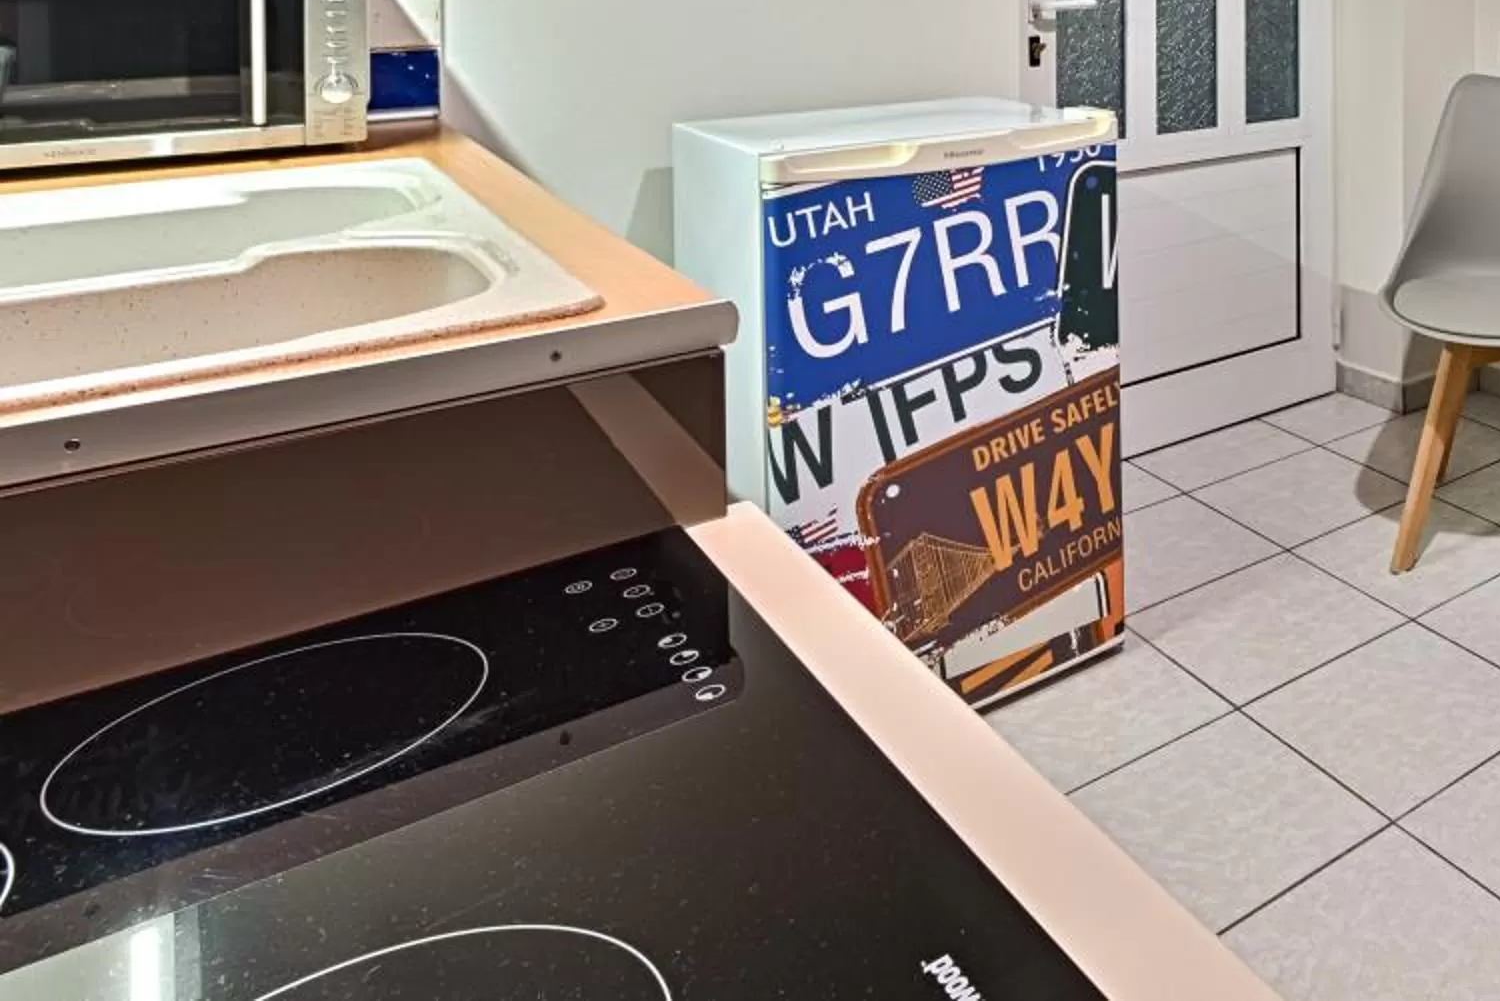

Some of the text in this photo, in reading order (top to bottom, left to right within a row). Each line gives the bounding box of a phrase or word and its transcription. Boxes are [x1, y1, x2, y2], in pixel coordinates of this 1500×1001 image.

[767, 191, 876, 248] UTAH
[786, 189, 1062, 359] G7RR
[968, 421, 1116, 572] W4Y
[972, 417, 1045, 472] DRIVE
